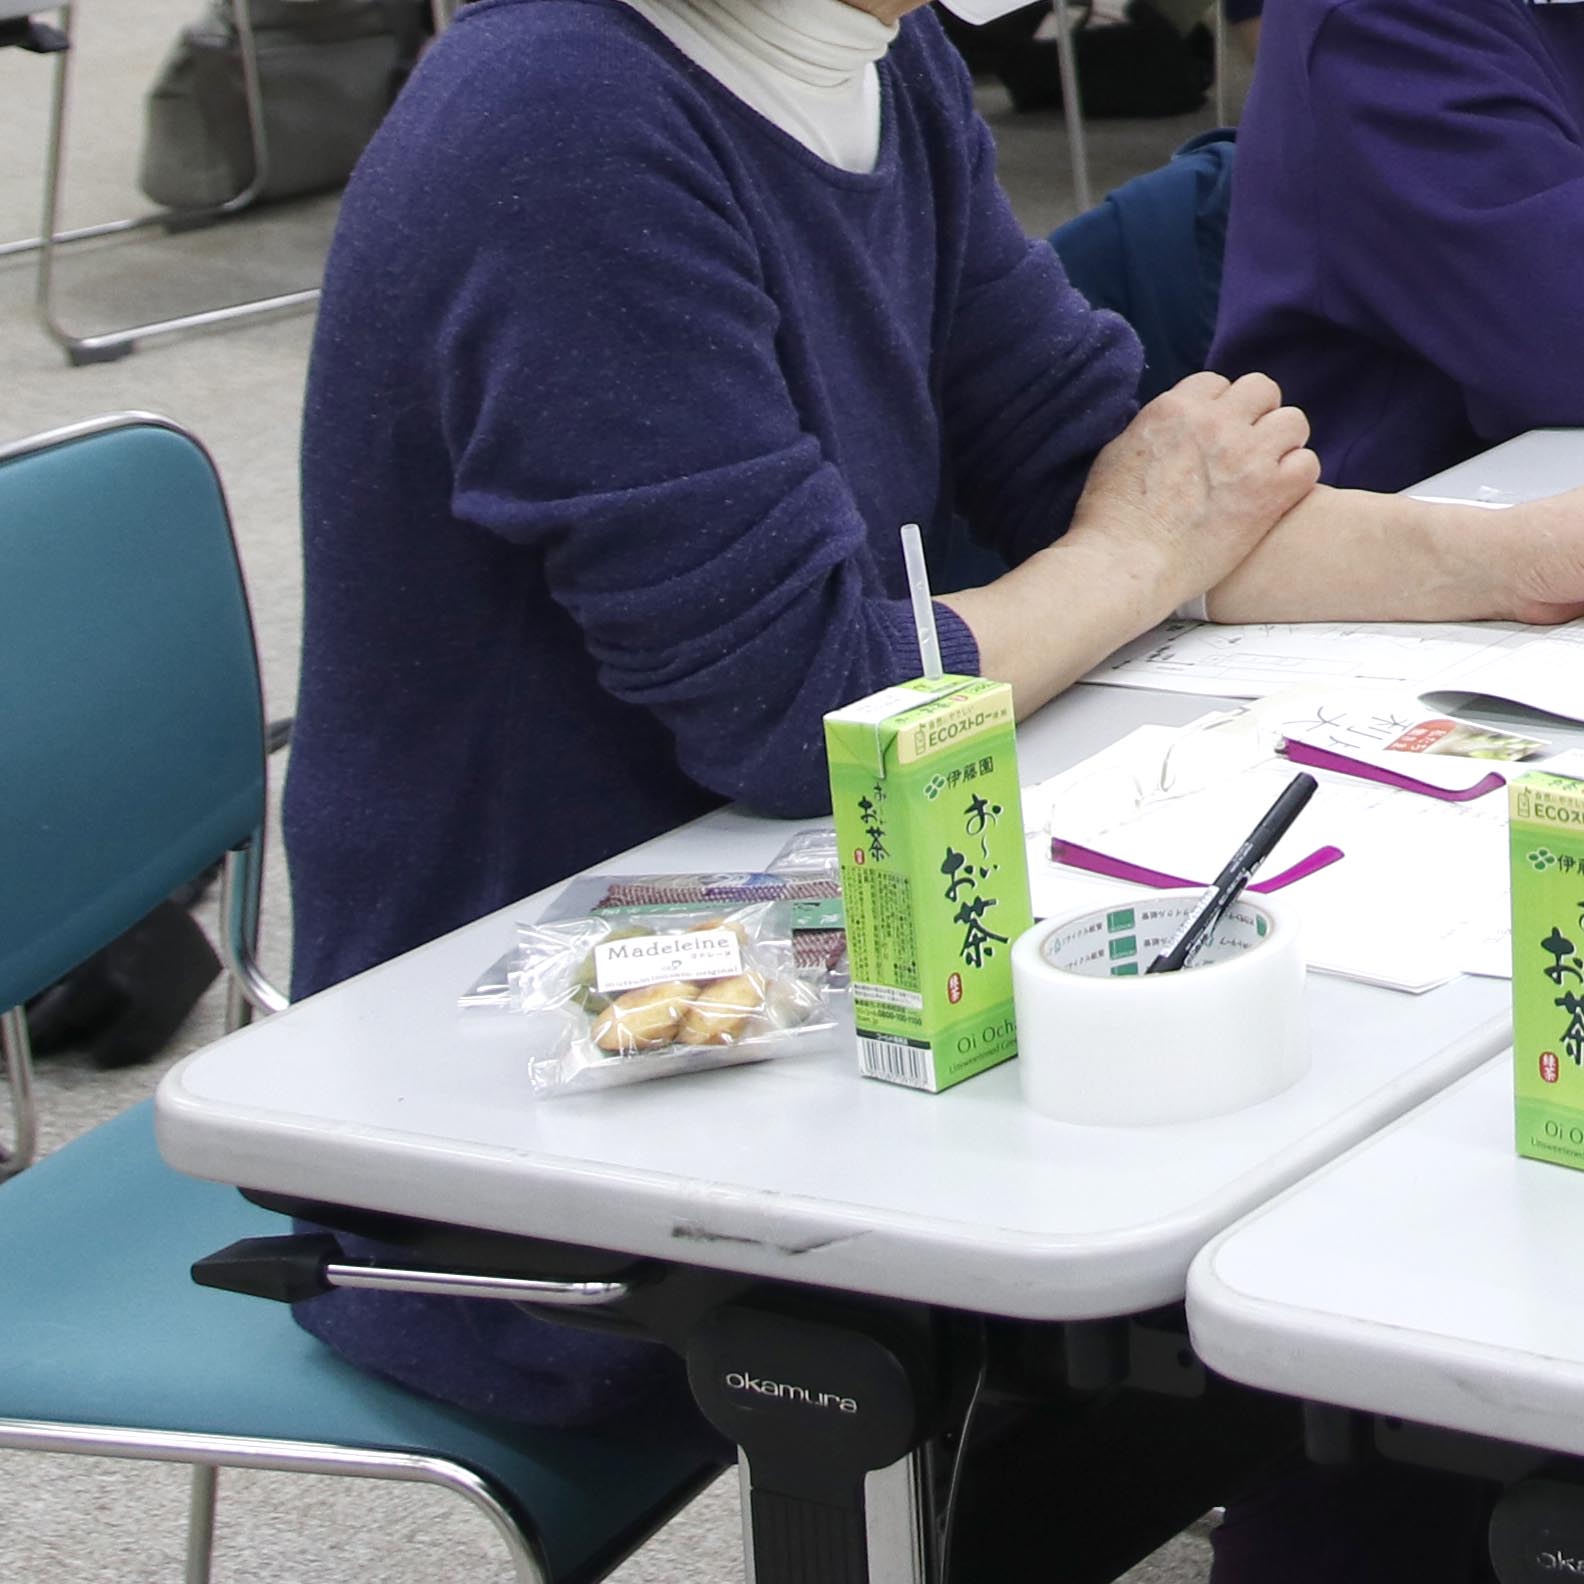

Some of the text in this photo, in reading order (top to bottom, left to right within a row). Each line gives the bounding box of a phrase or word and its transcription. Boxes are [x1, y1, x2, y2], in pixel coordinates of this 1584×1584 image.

[947, 756, 994, 789] 伊藤園
[608, 938, 729, 960] Madeleine
[957, 1021, 1017, 1053] Oi Och
[1544, 1120, 1564, 1138] Oi
[725, 1371, 858, 1414] okamura
